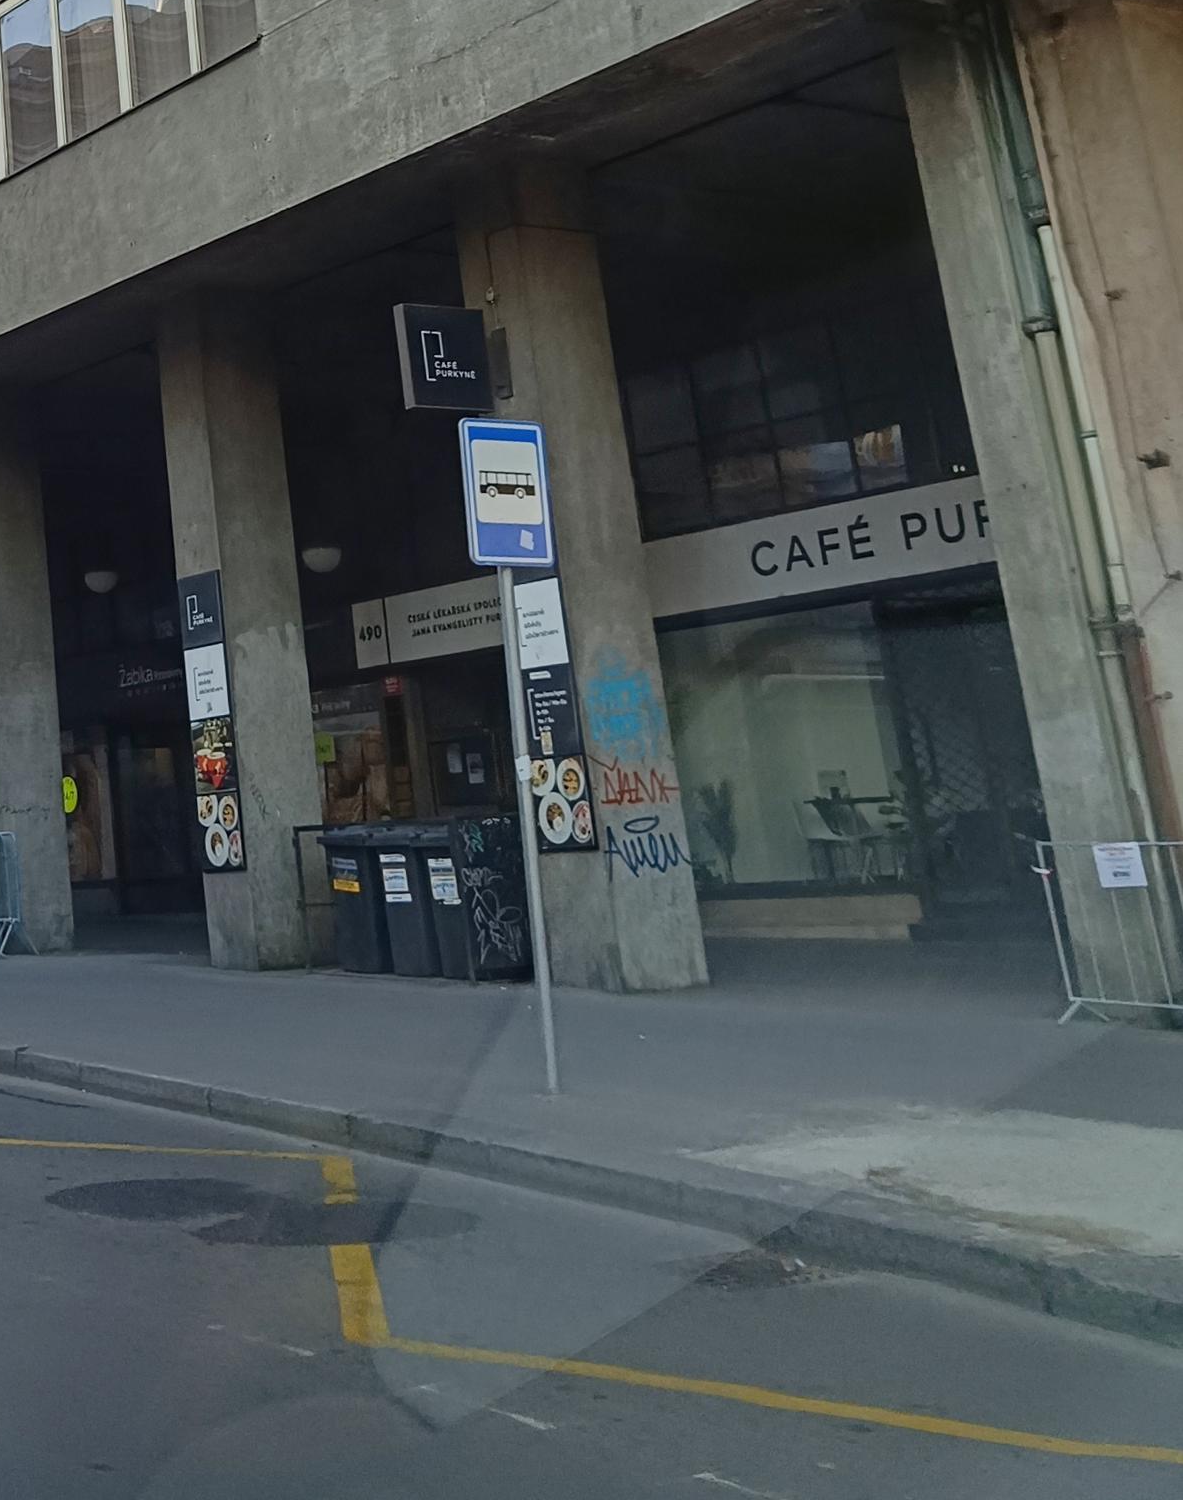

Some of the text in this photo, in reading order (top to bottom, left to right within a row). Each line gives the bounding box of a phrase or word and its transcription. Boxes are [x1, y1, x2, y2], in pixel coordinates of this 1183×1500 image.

[750, 514, 875, 576] CAFÉ
[407, 610, 431, 623] ČESKÁ
[433, 603, 471, 619] LÉKAŘSKÁ
[359, 624, 382, 642] 490
[411, 626, 431, 638] JANA
[433, 616, 483, 634] EVANGELISTY
